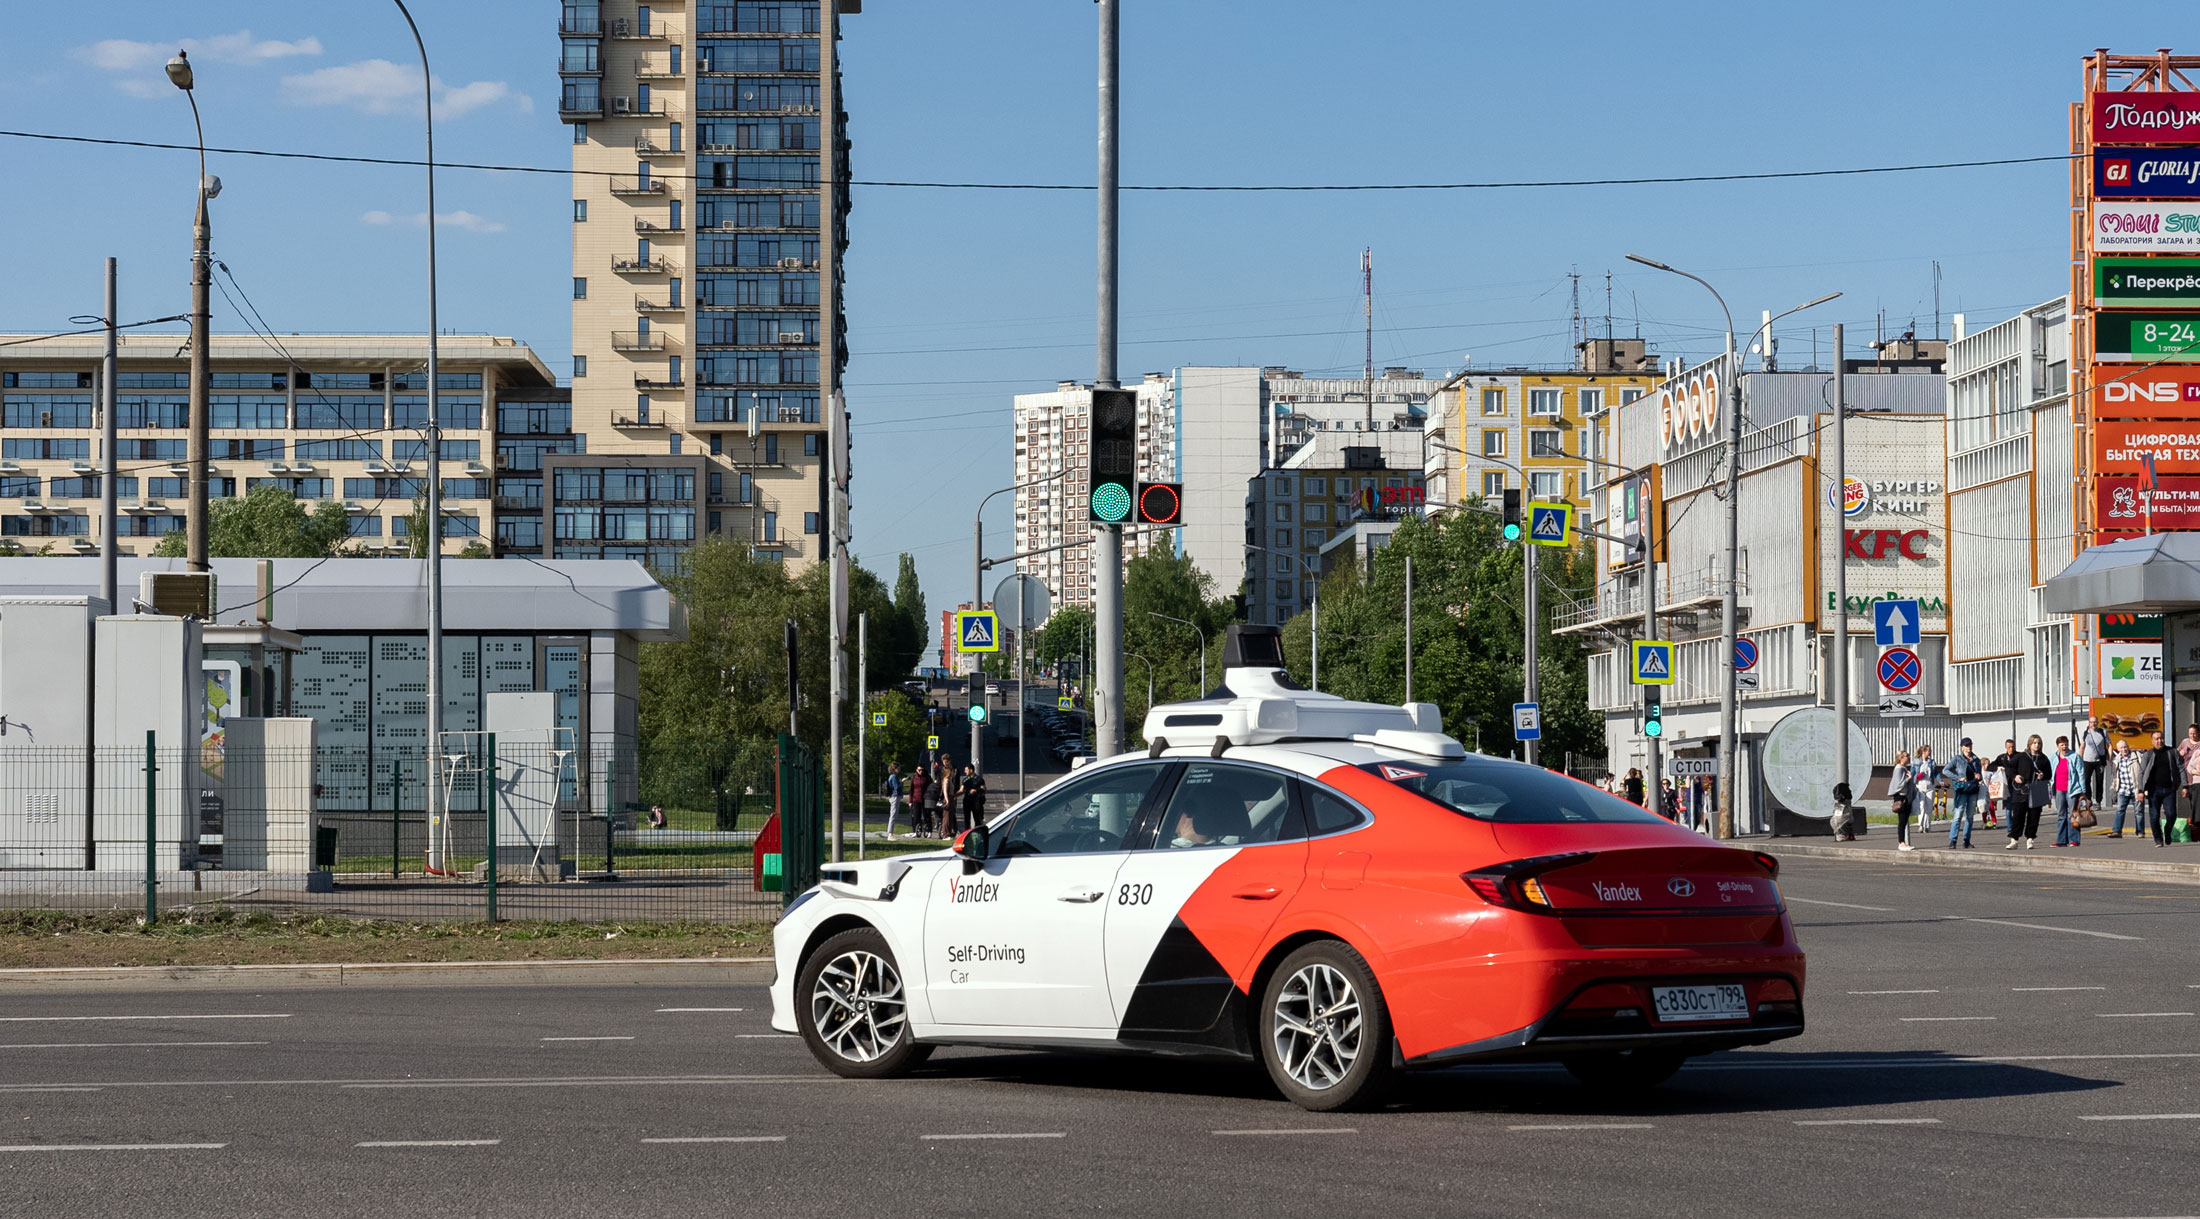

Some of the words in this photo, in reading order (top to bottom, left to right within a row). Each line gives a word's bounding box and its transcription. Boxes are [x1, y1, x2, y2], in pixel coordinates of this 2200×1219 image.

[2106, 164, 2127, 180] GJ
[2137, 161, 2189, 183] GLORIA
[2104, 382, 2179, 402] DNS
[1872, 480, 1938, 493] БУРГЕР
[1872, 500, 1926, 513] КИНГ
[2138, 505, 2158, 514] ДМ
[2160, 505, 2183, 513] БЫТА
[1844, 529, 1929, 559] KFC
[1652, 705, 1660, 717] 3
[1675, 760, 1711, 773] СТОП
[950, 875, 1000, 903] Yandex
[1118, 883, 1153, 905] 830
[1592, 880, 1642, 901] Yandex
[948, 944, 1025, 964] Self-Driving
[950, 969, 969, 984] Car
